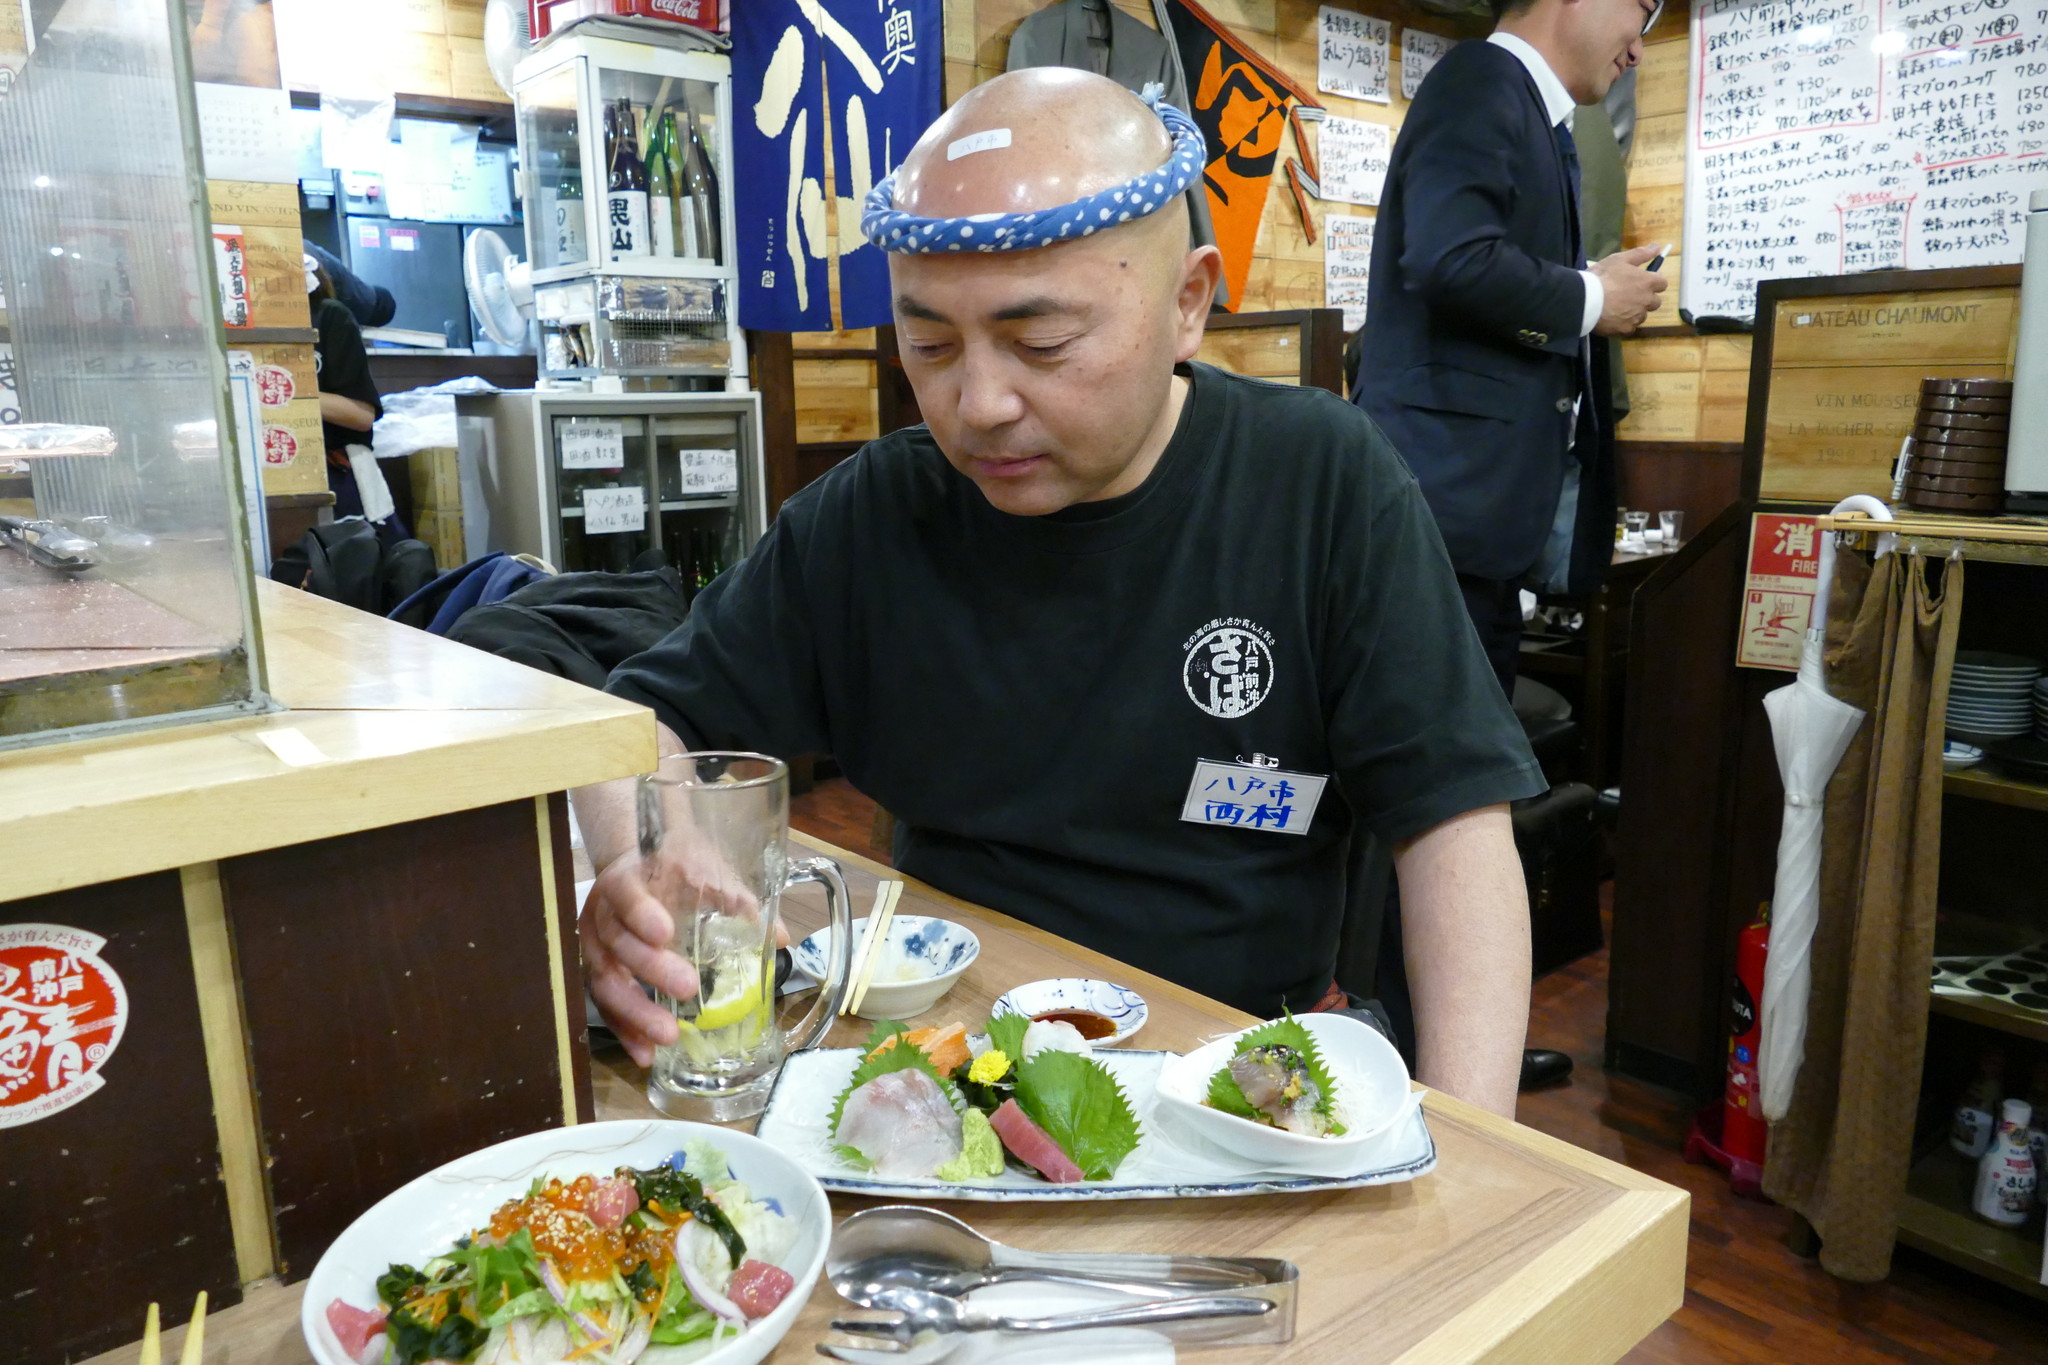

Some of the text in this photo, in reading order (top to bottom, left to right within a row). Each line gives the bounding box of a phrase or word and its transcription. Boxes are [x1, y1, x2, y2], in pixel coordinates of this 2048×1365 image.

[235, 204, 259, 213] VIN
[1875, 304, 1981, 327] CHAUMONT
[1816, 394, 1845, 409] VIN
[1773, 522, 1815, 558] 消
[1791, 559, 1818, 575] FIRE
[1209, 634, 1245, 715] さば
[1242, 640, 1261, 705] 八戸前沖
[1205, 776, 1297, 807] 八戸市
[1205, 799, 1297, 828] 西村
